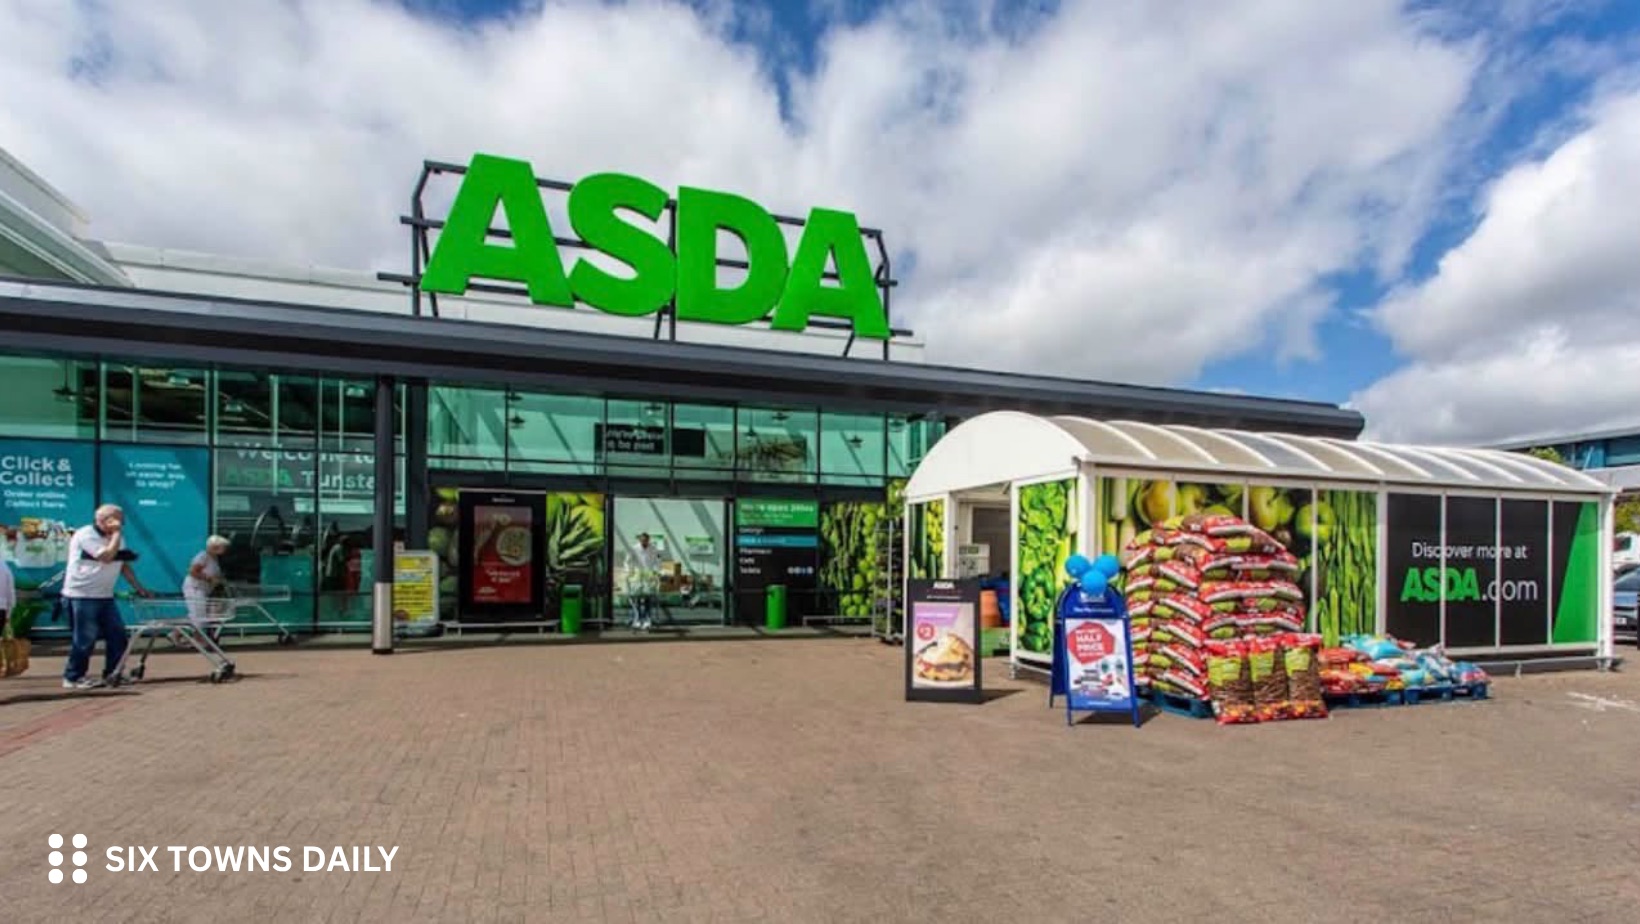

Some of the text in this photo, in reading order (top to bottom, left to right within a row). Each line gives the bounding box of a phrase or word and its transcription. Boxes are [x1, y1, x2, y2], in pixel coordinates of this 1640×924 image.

[419, 152, 892, 340] ASDA
[1, 455, 72, 472] Click &
[0, 470, 75, 487] Collect
[1411, 541, 1528, 559] Discover more at
[1400, 566, 1538, 602] ASDA.com
